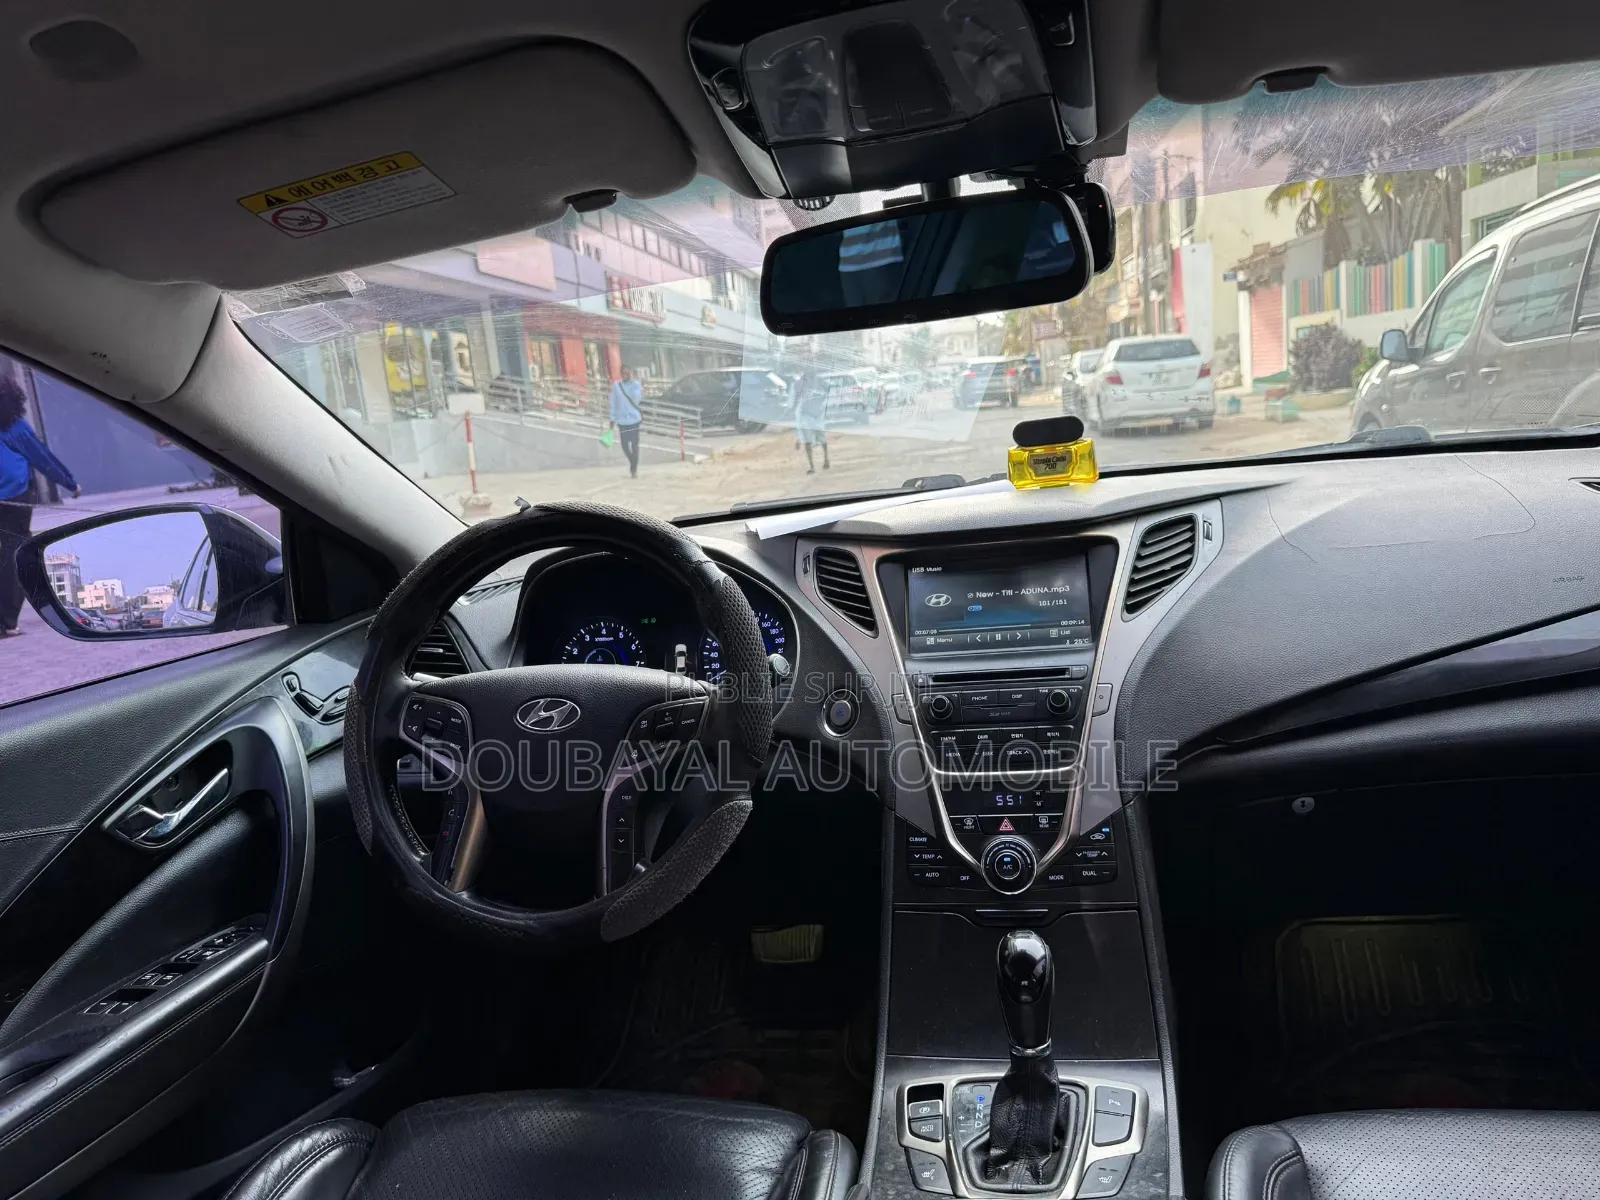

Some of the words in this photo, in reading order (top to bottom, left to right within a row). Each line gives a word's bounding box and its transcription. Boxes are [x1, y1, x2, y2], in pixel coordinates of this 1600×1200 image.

[976, 591, 994, 599] New
[1020, 585, 1070, 596] ADUNA.mp3
[976, 1095, 986, 1103] P
[974, 1120, 983, 1128] D
